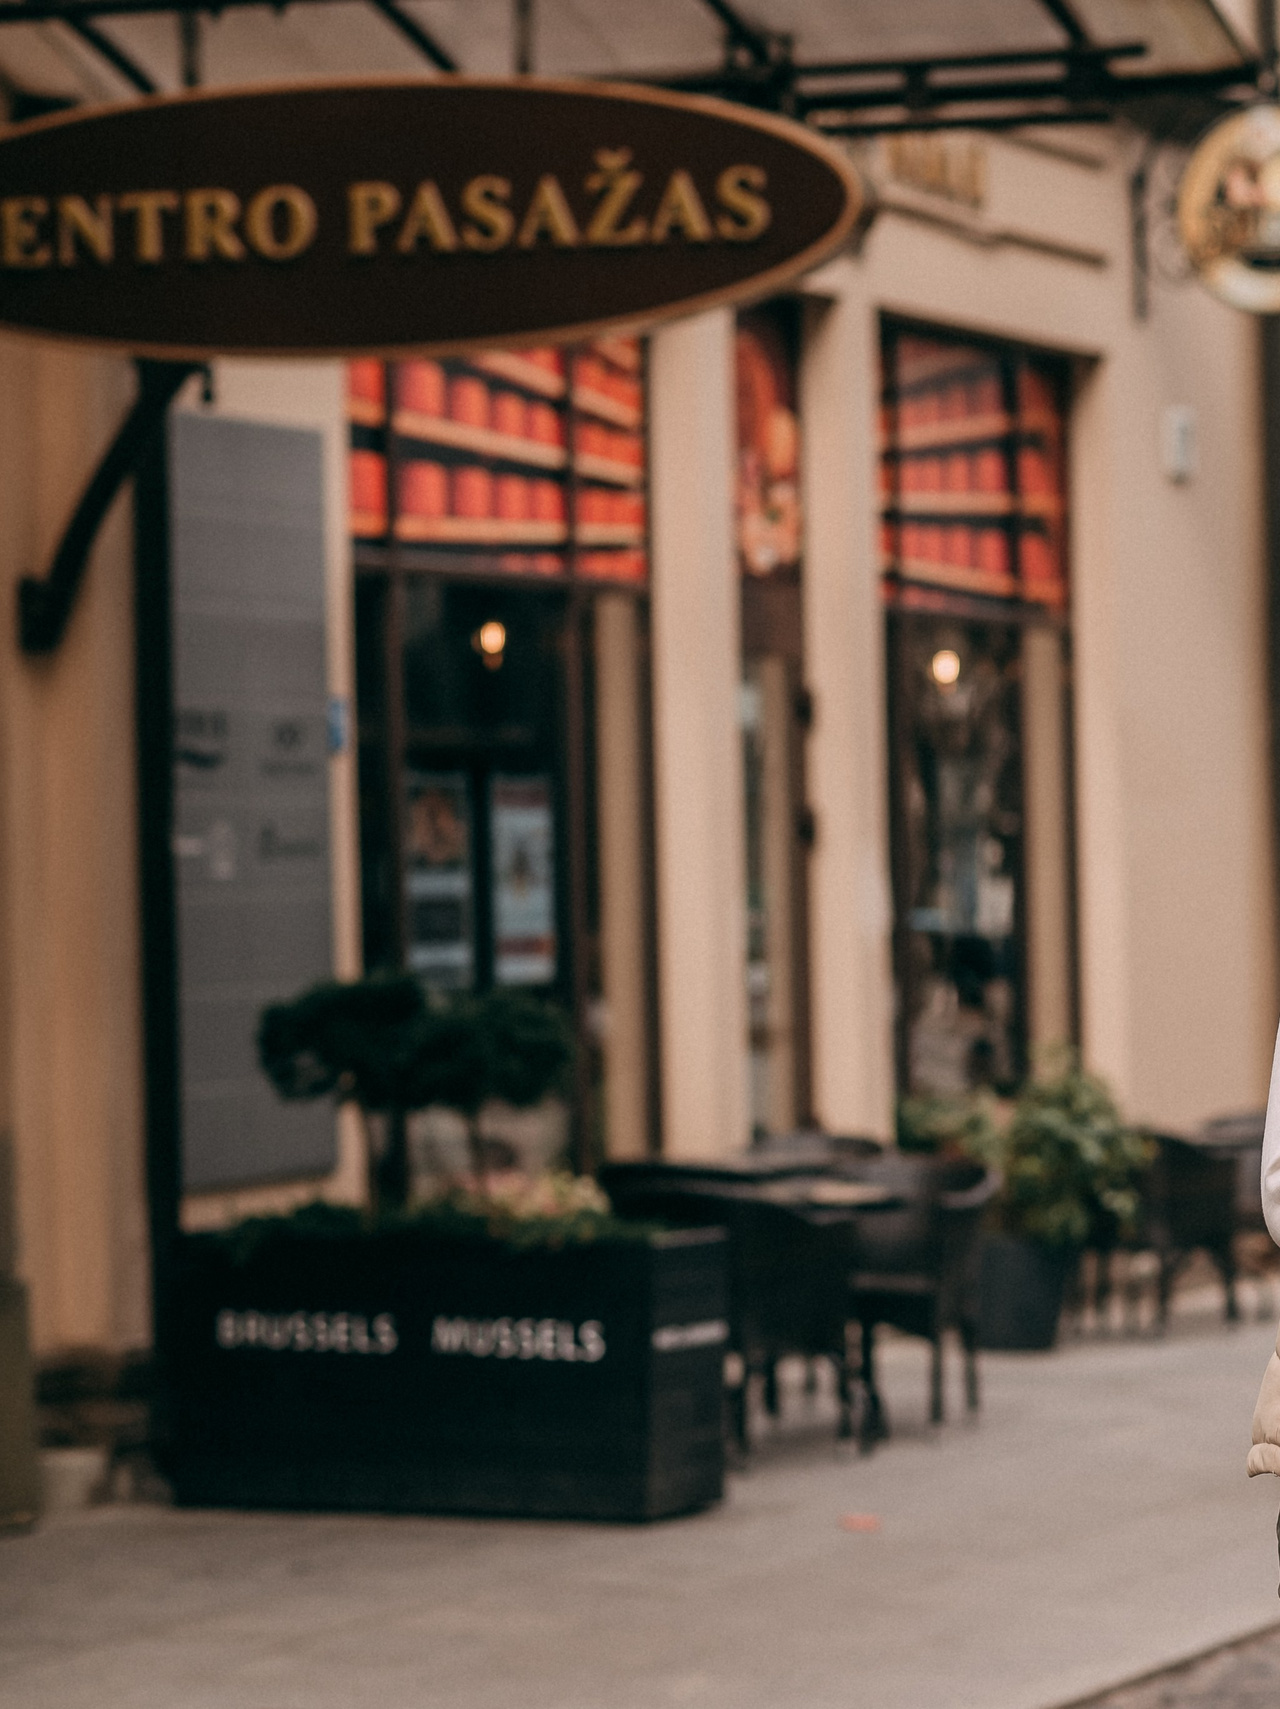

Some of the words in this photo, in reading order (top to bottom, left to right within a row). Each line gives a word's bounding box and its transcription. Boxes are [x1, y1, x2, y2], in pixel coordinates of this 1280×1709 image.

[347, 145, 773, 254] PASAŽAS
[217, 1309, 399, 1354] BRUSSELS
[431, 1315, 606, 1363] MUSSELS
